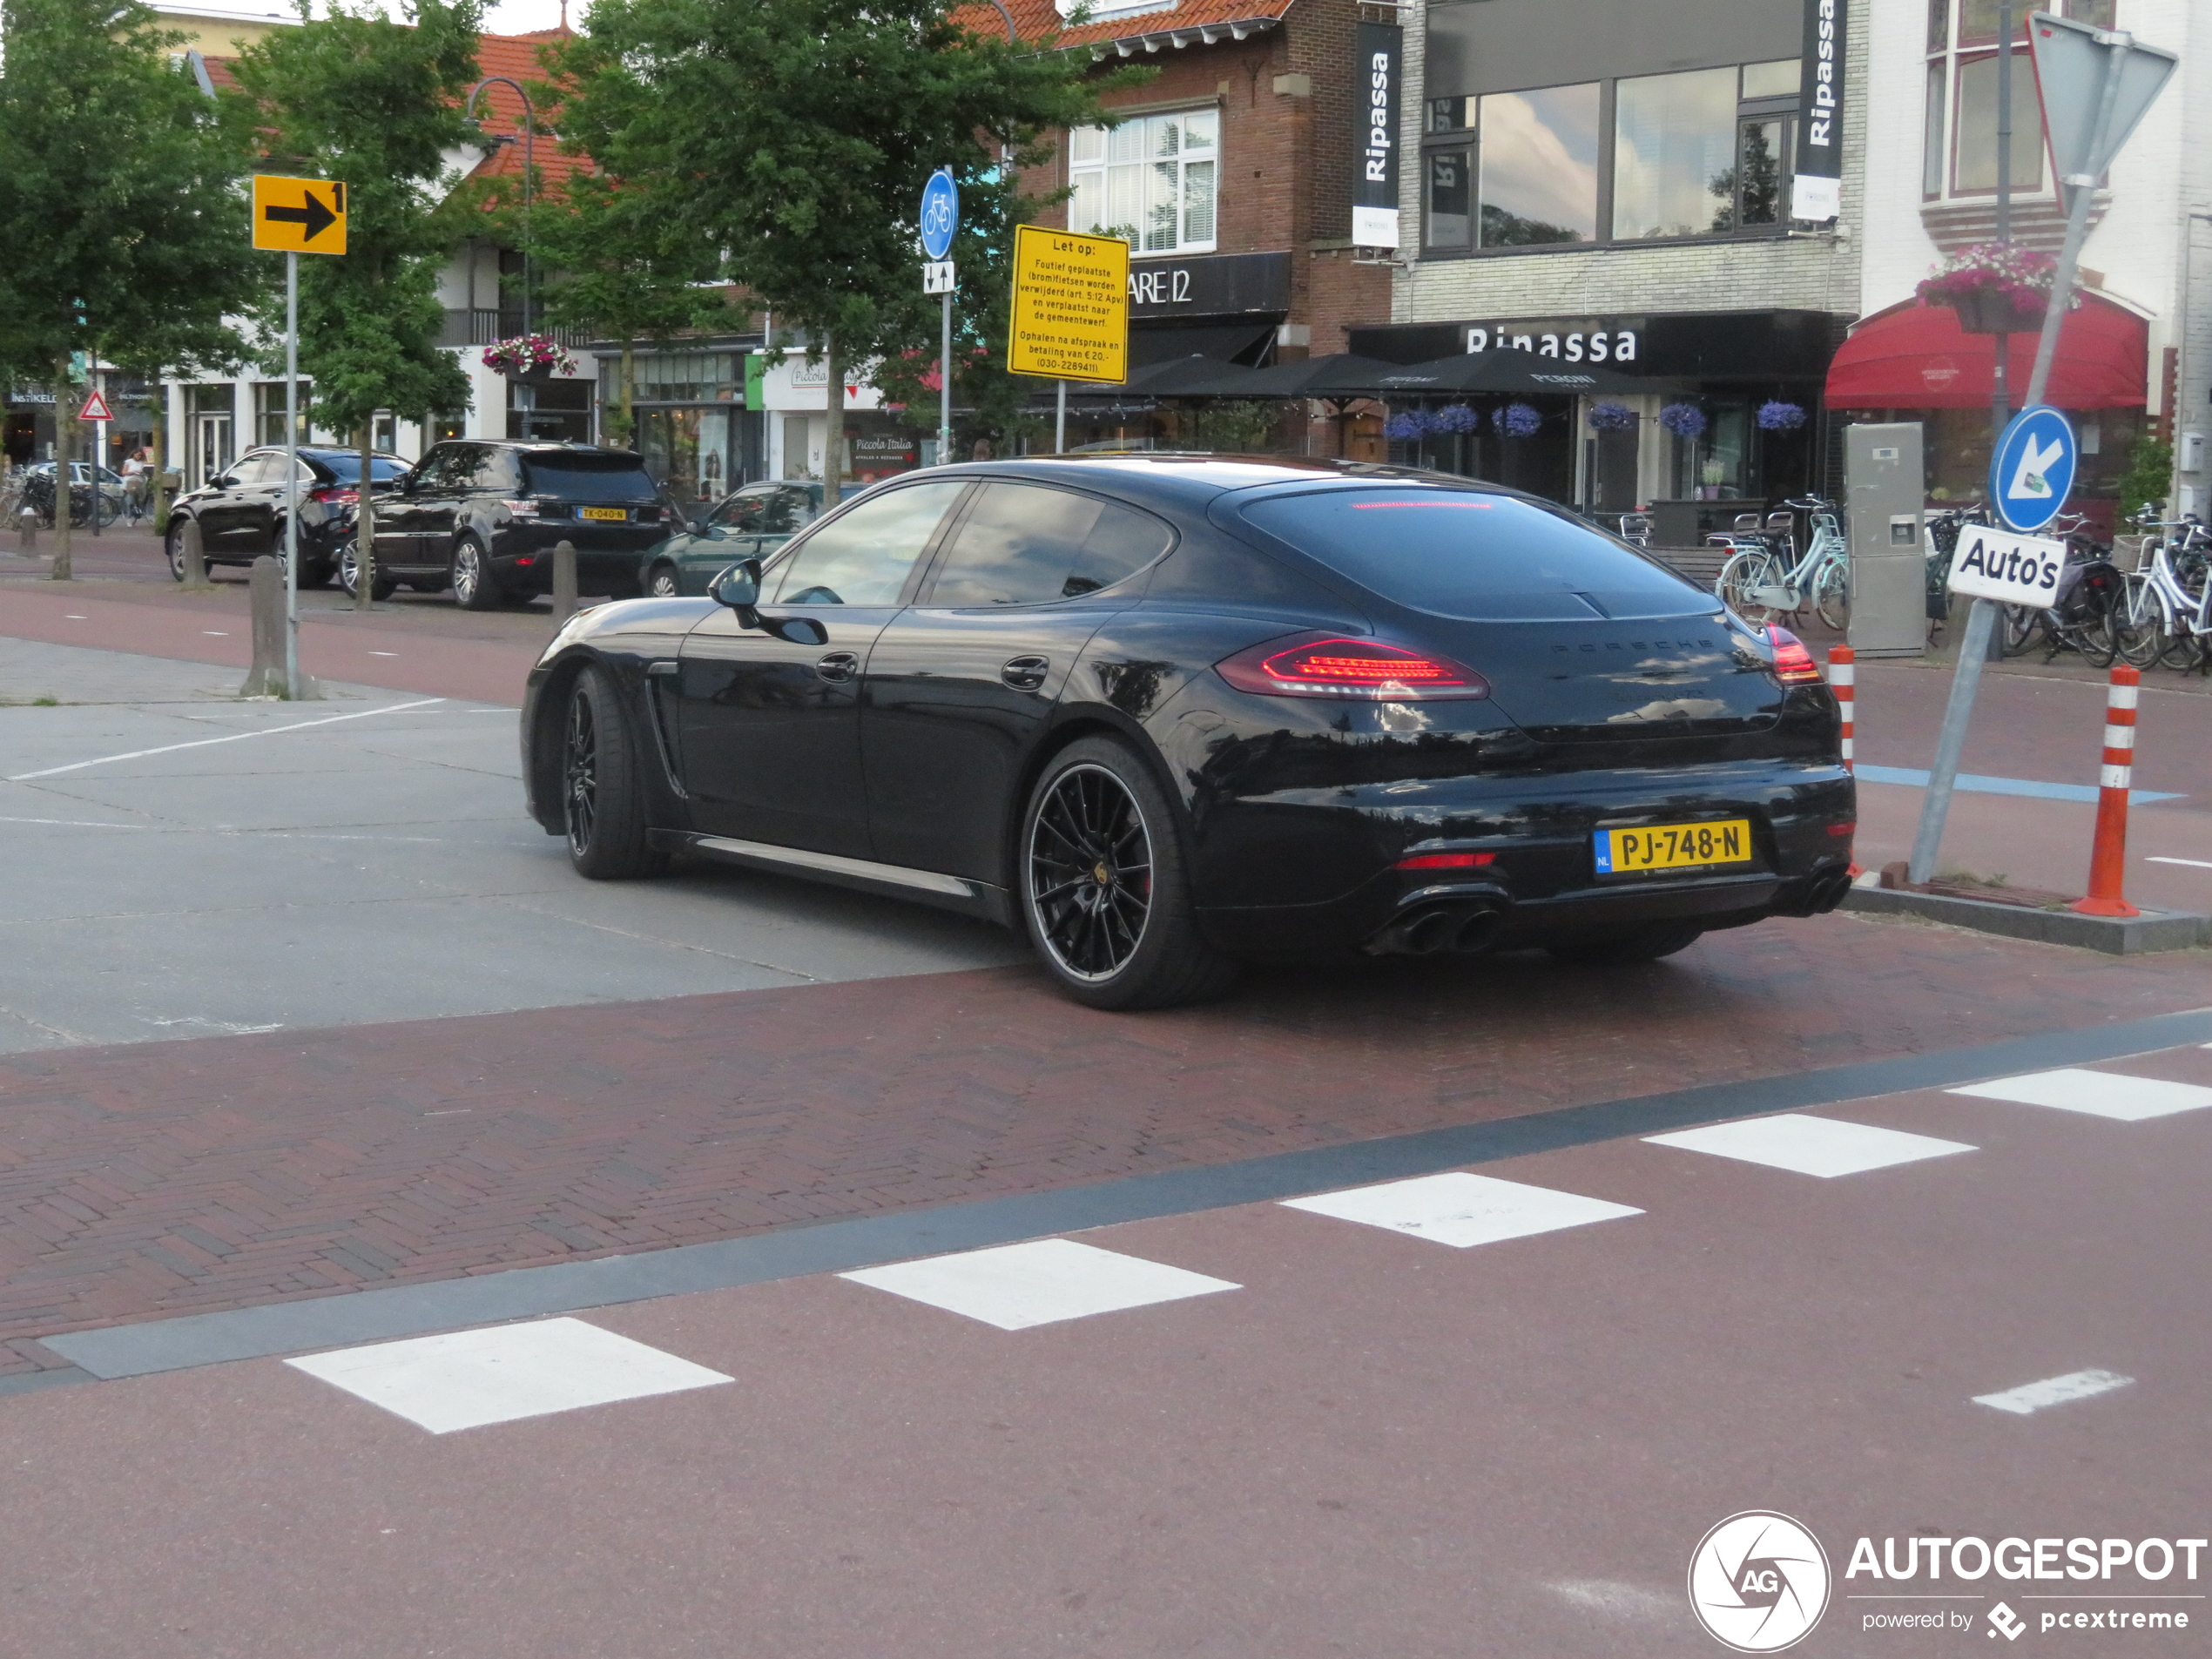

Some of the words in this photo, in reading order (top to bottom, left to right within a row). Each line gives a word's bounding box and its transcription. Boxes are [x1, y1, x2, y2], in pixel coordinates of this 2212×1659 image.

[1810, 0, 1836, 146] Ripassa
[1366, 52, 1392, 182] Ripassa
[331, 183, 343, 212] 1
[1053, 239, 1073, 253] Let
[1078, 244, 1096, 256] op:
[1035, 260, 1065, 271] Foutief
[1068, 265, 1111, 277] geplaatste
[1028, 271, 1084, 287] (brom)fietsen
[1087, 280, 1116, 290] worden
[1128, 272, 1166, 304] ARE
[1173, 270, 1192, 302] 12
[1020, 285, 1065, 297] verwijderd
[1067, 288, 1084, 299] (art.
[1087, 292, 1103, 301] 5:12
[1105, 294, 1123, 305] Apv)
[1046, 300, 1089, 313] verplaatst
[1091, 307, 1110, 315] naar
[1035, 311, 1044, 320] de
[1047, 314, 1108, 327] gemeentewerf.
[1020, 331, 1055, 343] Ophalen
[1058, 335, 1068, 344] na
[1070, 337, 1107, 348] afspraak
[1029, 345, 1064, 359] betaling
[1067, 350, 1082, 359] van
[1084, 351, 1090, 360] €
[795, 369, 827, 382] Piccola
[1529, 374, 1596, 384] PERONI
[856, 438, 886, 450] Piccola
[887, 438, 914, 450] Italia
[583, 509, 623, 518] TK-040-N
[1959, 538, 2058, 589] Auto's
[1551, 639, 1714, 653] PORSCHE
[1622, 826, 1739, 865] PJ-748-N
[1597, 857, 1608, 866] NL
